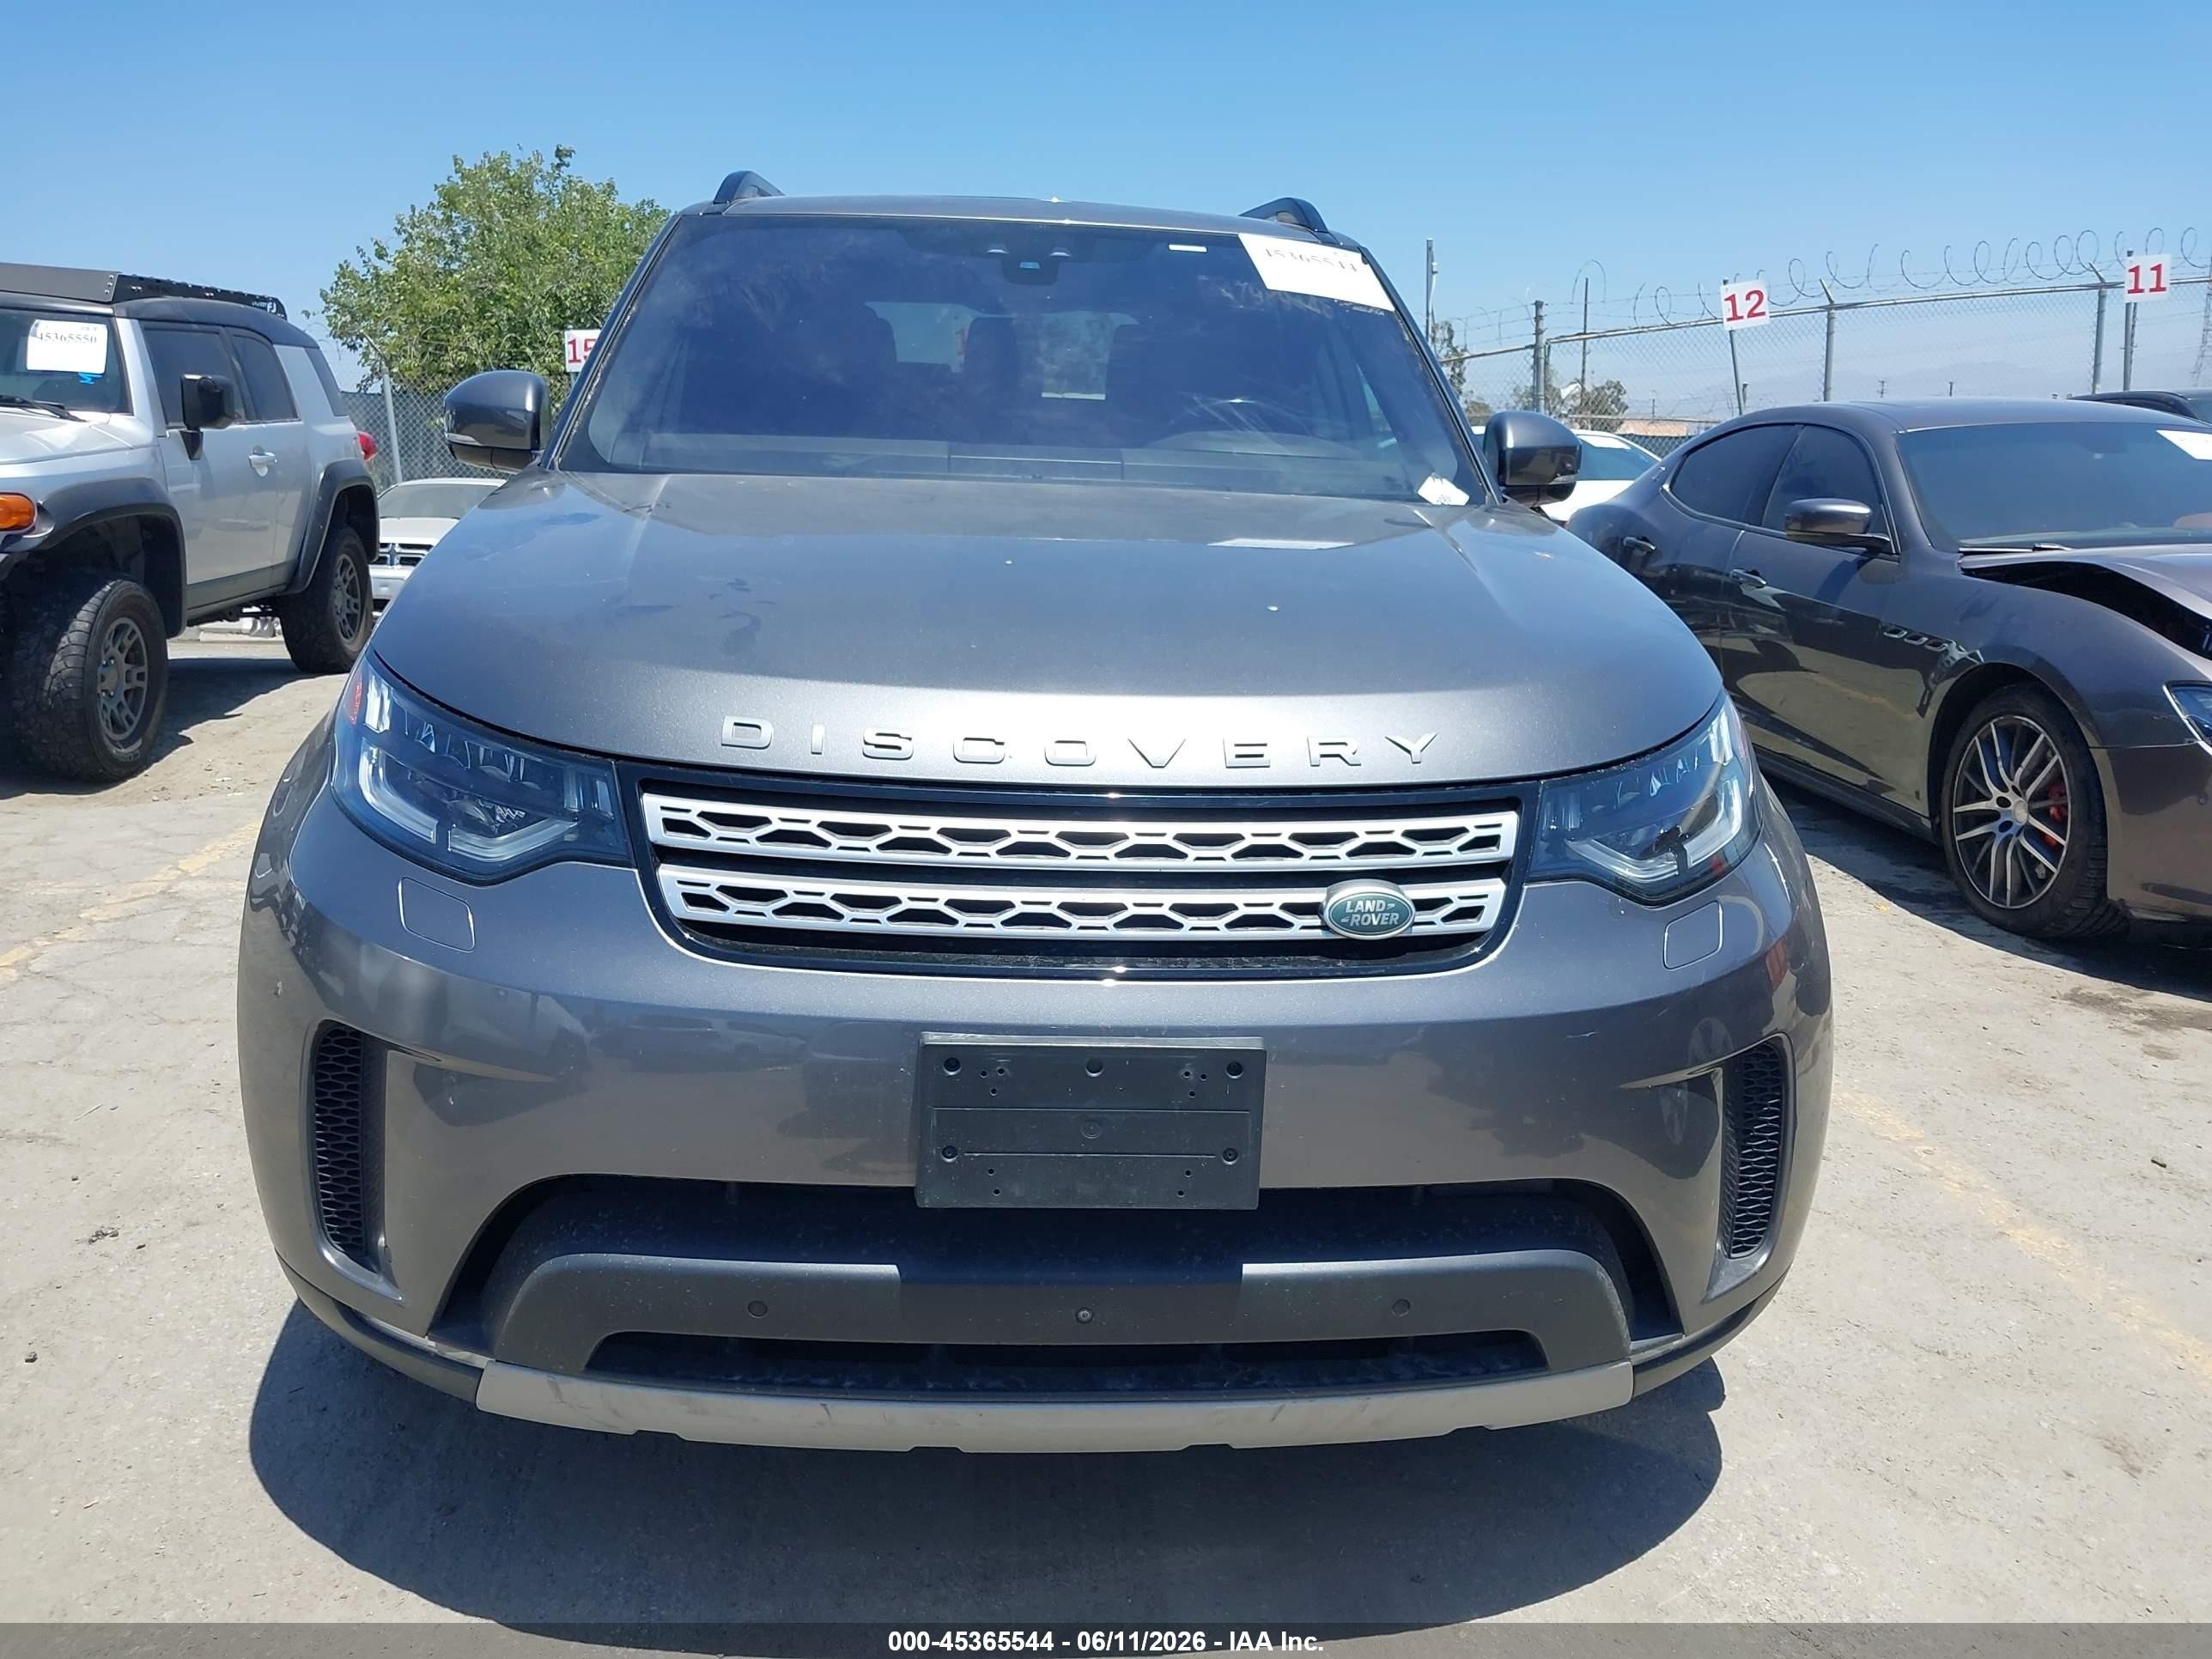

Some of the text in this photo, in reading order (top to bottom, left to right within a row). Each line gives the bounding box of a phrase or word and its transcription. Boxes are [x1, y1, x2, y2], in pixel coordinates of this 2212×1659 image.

[2128, 263, 2166, 294] 11
[1723, 289, 1765, 322] 12
[721, 714, 1438, 769] DISCOVERY
[1346, 899, 1386, 913] LAND
[1349, 912, 1400, 927] ROVER
